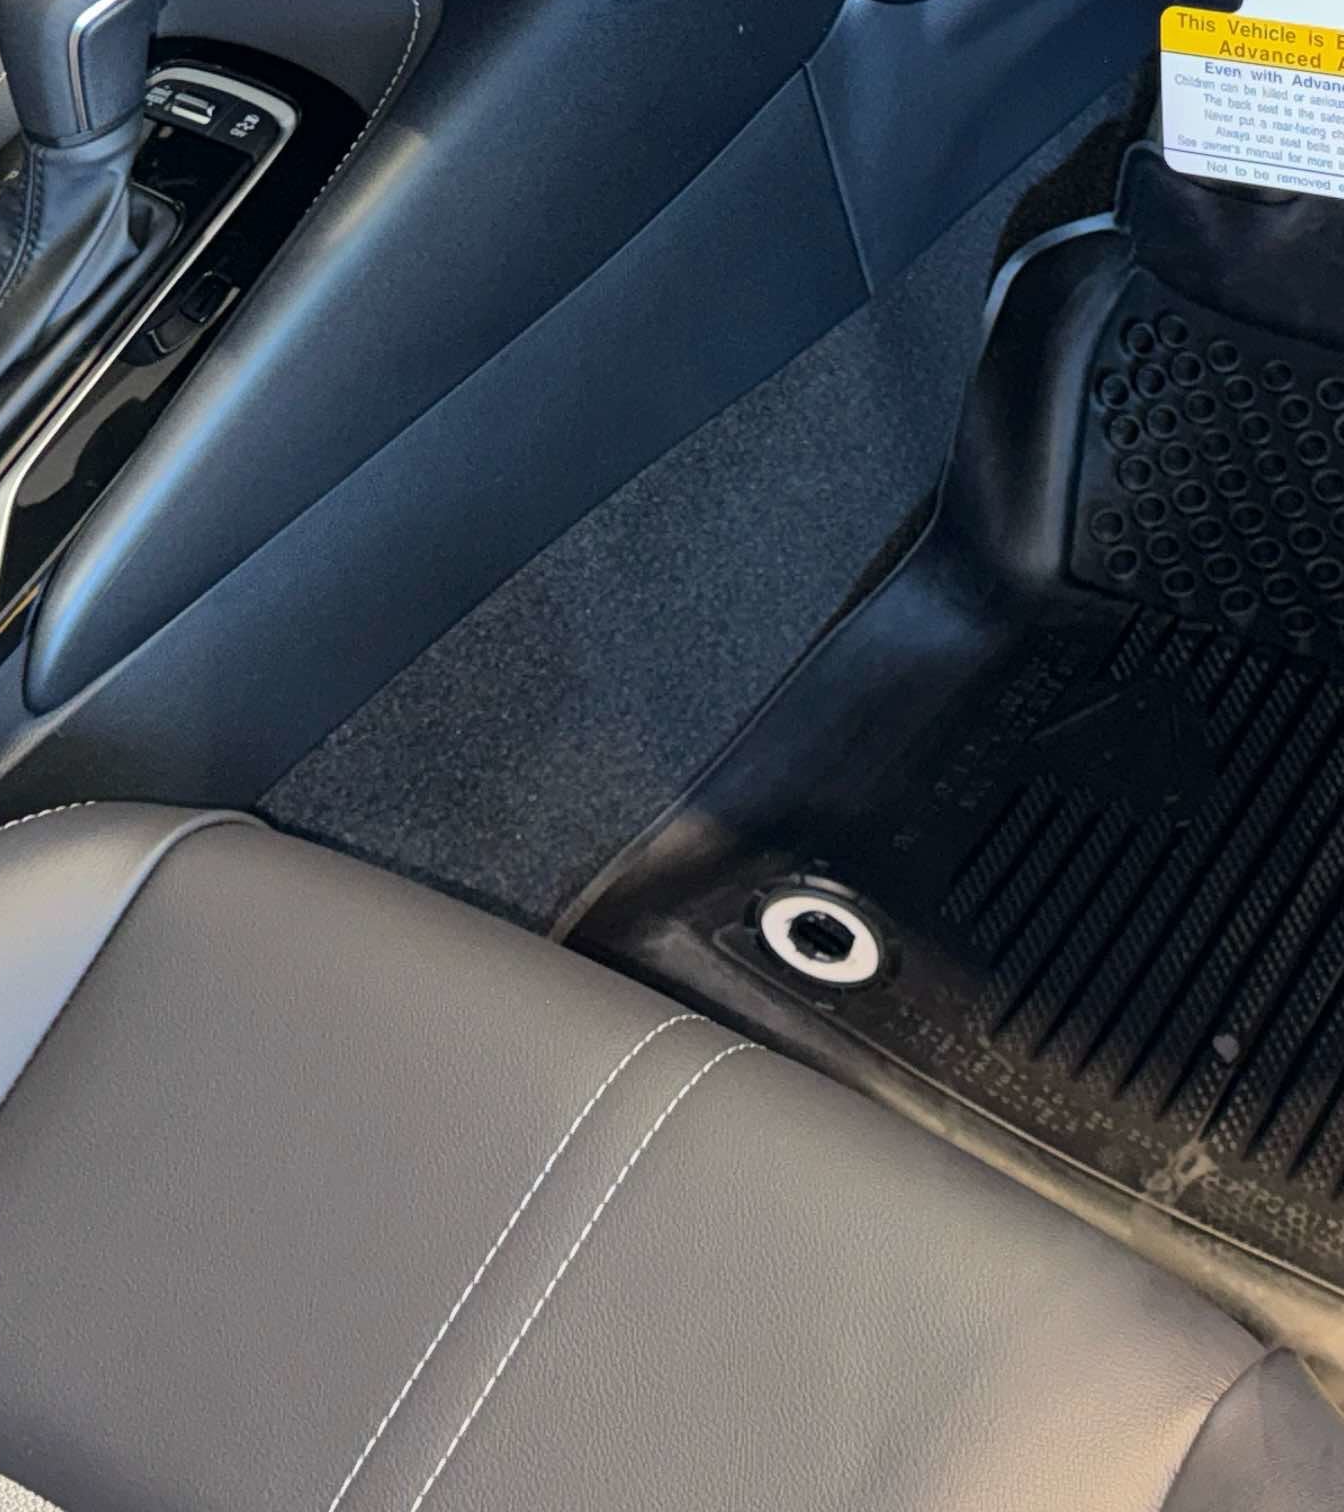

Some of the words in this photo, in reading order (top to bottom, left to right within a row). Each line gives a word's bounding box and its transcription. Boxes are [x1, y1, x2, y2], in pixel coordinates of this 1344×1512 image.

[1177, 12, 1216, 32] This
[1228, 19, 1296, 43] Vehicle
[1309, 31, 1324, 47] is
[1220, 40, 1321, 68] Advanced
[1205, 62, 1241, 78] Even
[1251, 68, 1283, 83] with
[1174, 74, 1215, 90] Children
[1244, 84, 1257, 96] be
[1294, 93, 1305, 102] or
[1204, 93, 1222, 106] The
[1228, 96, 1251, 110] back
[1257, 102, 1279, 114] seat
[1285, 105, 1293, 116] is
[1298, 107, 1314, 119] the
[1204, 110, 1233, 123] Never
[1239, 116, 1255, 127] put
[1260, 119, 1267, 128] a
[1273, 120, 1326, 139] rear-facing
[1216, 126, 1250, 142] Always
[1255, 133, 1274, 144] use
[1280, 136, 1301, 148] seat
[1177, 133, 1197, 147] See
[1247, 146, 1283, 161] manual
[1288, 151, 1303, 163] for
[1307, 157, 1333, 169] more
[1206, 160, 1228, 174] Not
[1235, 166, 1247, 177] to
[1254, 167, 1269, 181] be
[1276, 172, 1331, 192] removed
